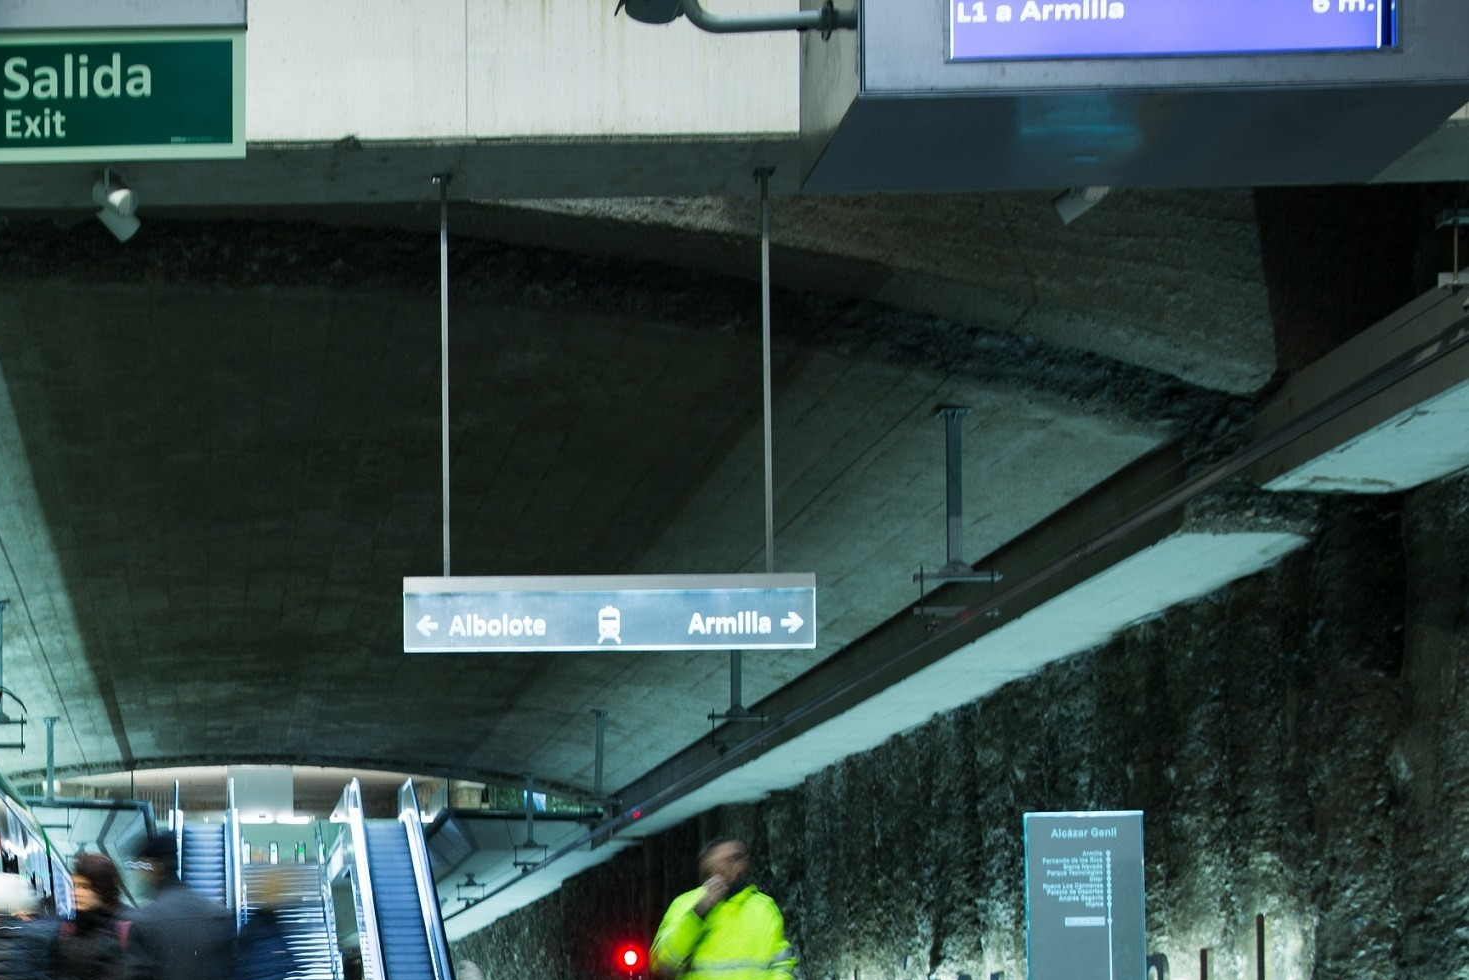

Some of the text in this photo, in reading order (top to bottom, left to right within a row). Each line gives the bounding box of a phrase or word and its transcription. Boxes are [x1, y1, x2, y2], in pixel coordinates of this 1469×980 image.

[957, 0, 988, 23] L1
[995, 5, 1012, 22] a
[1019, 0, 1125, 22] Armilla
[3, 52, 152, 100] Salida
[5, 108, 66, 139] Exit
[448, 613, 547, 637] Albolote
[687, 611, 772, 635] Armilla
[1051, 826, 1117, 839] Alcázar Genil
